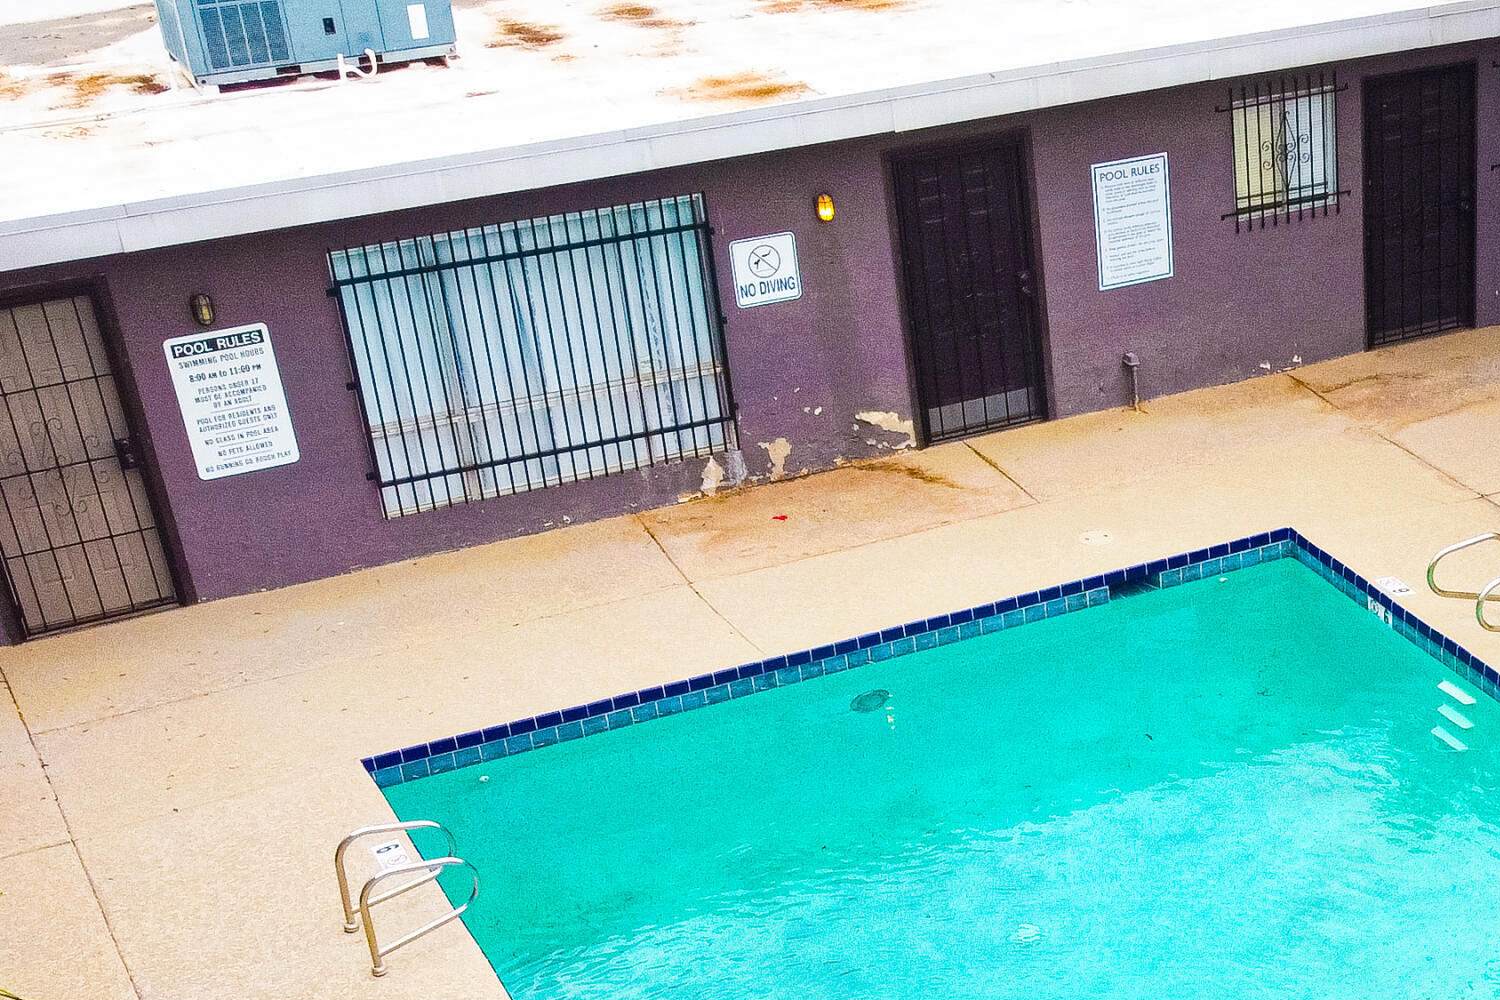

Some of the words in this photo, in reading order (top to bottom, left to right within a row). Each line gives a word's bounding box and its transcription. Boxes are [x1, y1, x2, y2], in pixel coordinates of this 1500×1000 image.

[1100, 169, 1128, 182] POOL
[1131, 163, 1160, 177] RULES
[740, 283, 757, 299] NO
[759, 276, 796, 295] DIVING
[174, 341, 214, 357] POOL
[216, 332, 261, 350] RULES
[178, 356, 217, 369] SWIMMING
[220, 352, 238, 362] POOL
[240, 347, 264, 358] HOURS
[252, 363, 261, 371] PM
[376, 844, 399, 854] 6
